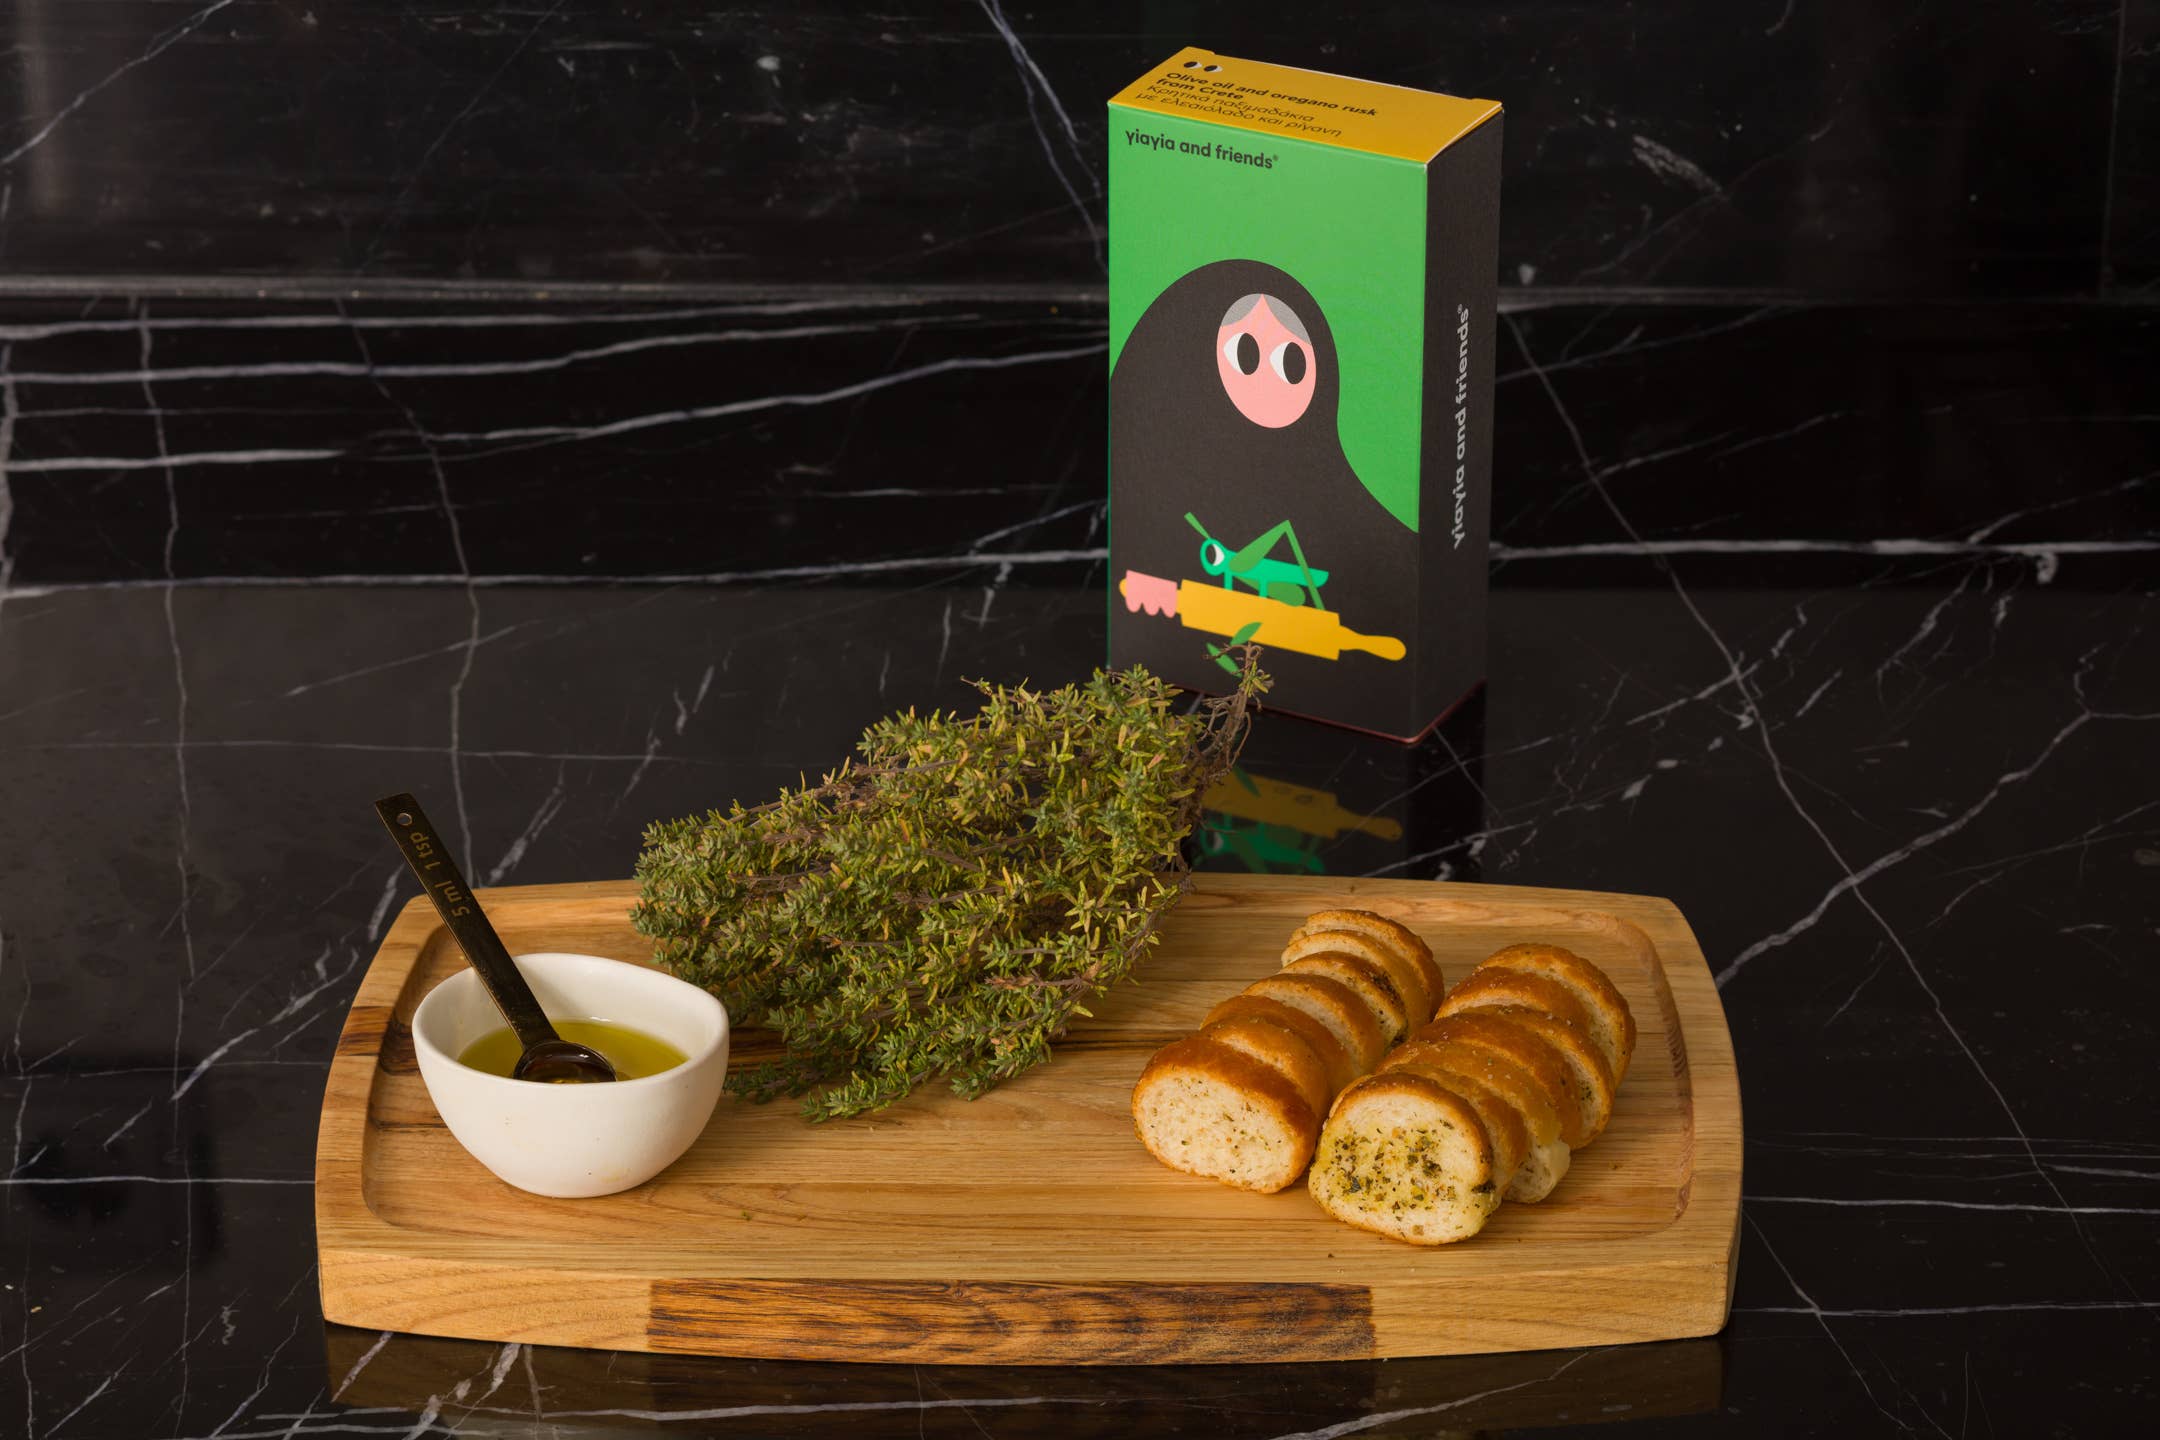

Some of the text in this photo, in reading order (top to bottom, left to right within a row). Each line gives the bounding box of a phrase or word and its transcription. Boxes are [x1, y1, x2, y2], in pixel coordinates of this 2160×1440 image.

[1156, 78, 1244, 99] from Crete
[1166, 72, 1377, 116] Olive oil and oregano rusk
[1179, 141, 1212, 158] and
[1454, 406, 1467, 461] and
[410, 831, 433, 859] tsp
